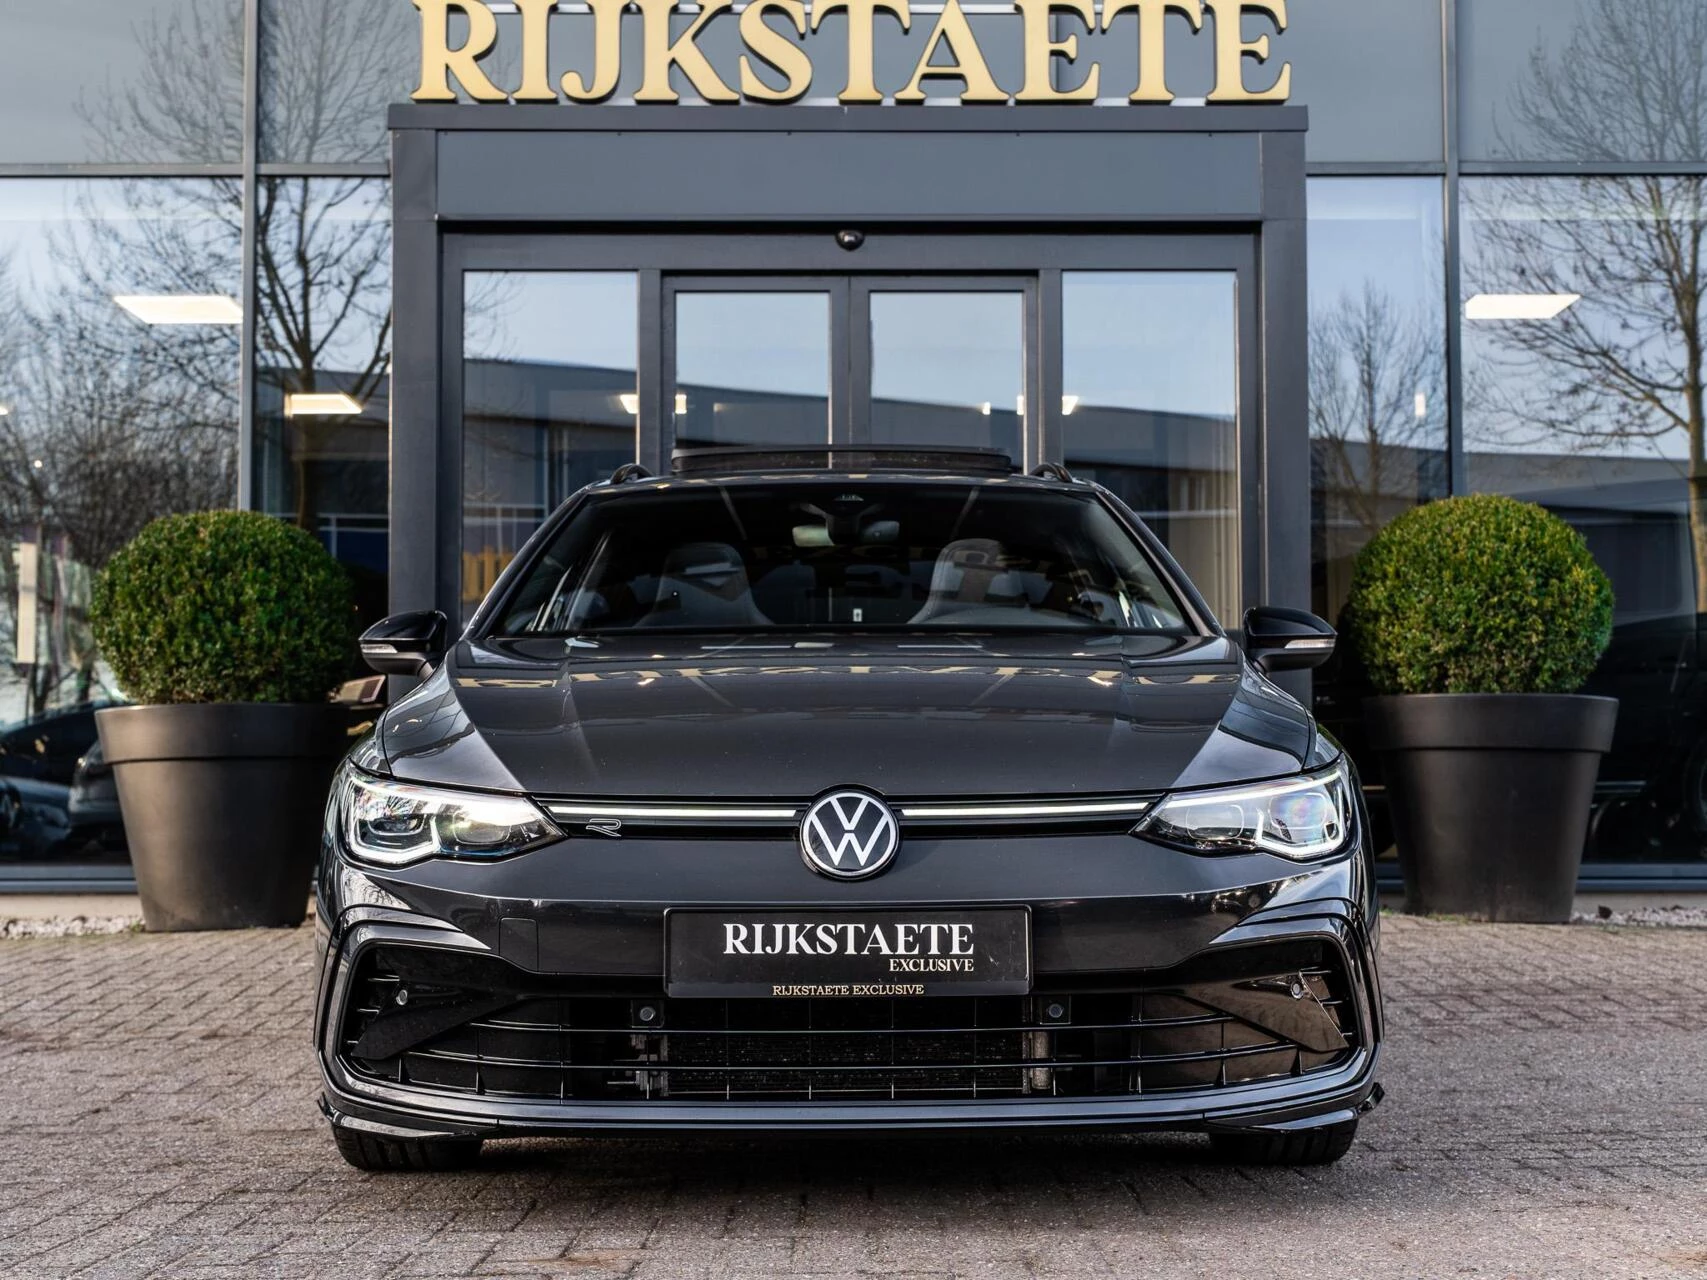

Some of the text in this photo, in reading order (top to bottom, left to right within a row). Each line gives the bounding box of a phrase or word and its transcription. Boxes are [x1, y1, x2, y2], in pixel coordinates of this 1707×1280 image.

[409, 0, 1291, 103] RIJKSTAETE
[722, 923, 975, 955] RIJKSTAETE
[889, 958, 975, 973] EXCLUSIVE
[772, 984, 925, 996] RIJKSTAETE EXCLUSIVE
